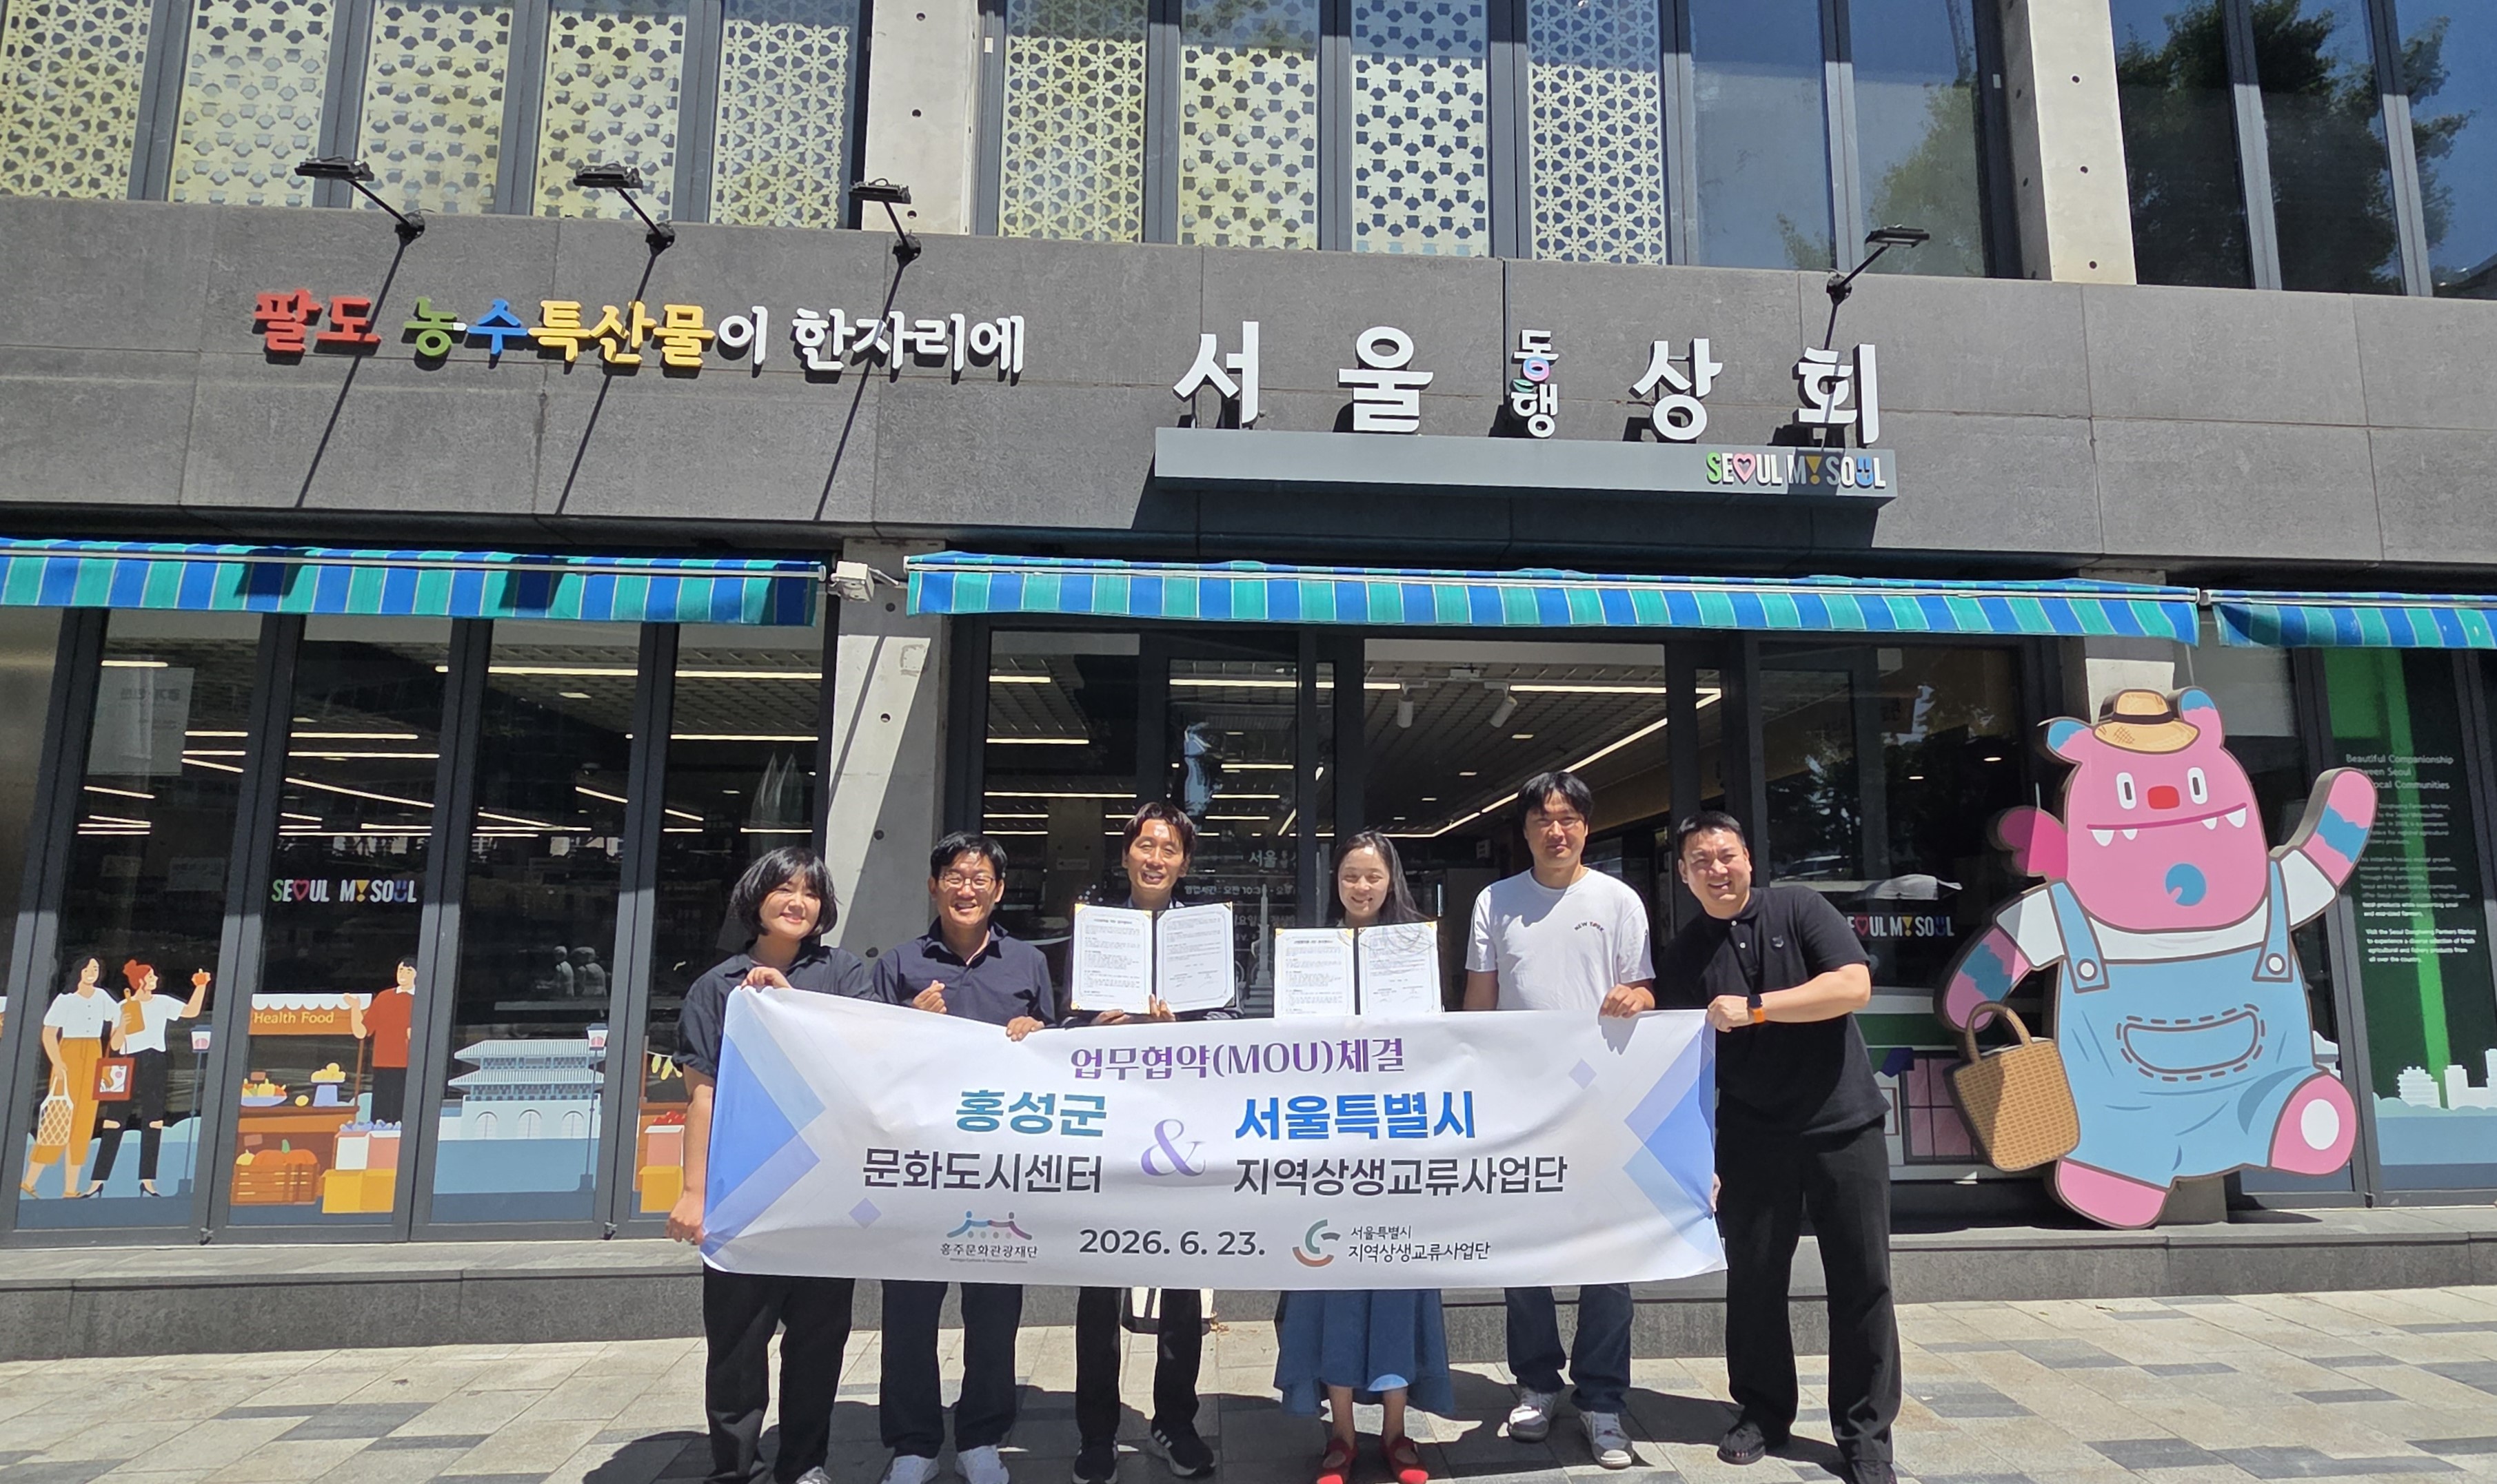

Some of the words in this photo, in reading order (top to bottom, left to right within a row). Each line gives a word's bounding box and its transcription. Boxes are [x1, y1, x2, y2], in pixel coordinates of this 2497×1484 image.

[252, 288, 381, 354] 팔도
[403, 296, 769, 367] 농수특산물이
[792, 307, 1025, 374] 한자리에
[1826, 456, 1886, 487] SOUL
[2345, 754, 2386, 763] Beautiful
[2388, 754, 2454, 765] Companionship
[2387, 767, 2412, 776] Seoul
[2374, 780, 2392, 789] ocal
[2394, 780, 2450, 789] Communities
[1235, 914, 1257, 927] 요일
[253, 1011, 296, 1024] Health
[301, 1011, 334, 1024] Food
[1071, 1038, 1406, 1081] 업무협약(MOU)체결
[956, 1090, 1107, 1137] 홍성군
[1235, 1090, 1476, 1140] 서울특별시
[1140, 1119, 1206, 1177] &
[863, 1148, 1102, 1194] 문화도시센터
[1233, 1155, 1568, 1196] 지역상생교류사업단
[1078, 1228, 1171, 1255] 2026.
[1180, 1228, 1208, 1255] 6.
[1217, 1228, 1266, 1255] 23.
[1350, 1226, 1412, 1240] 서울특별시
[940, 1243, 1038, 1259] 홍주문화관광재단
[1348, 1241, 1491, 1263] 지역상생교류사업단
